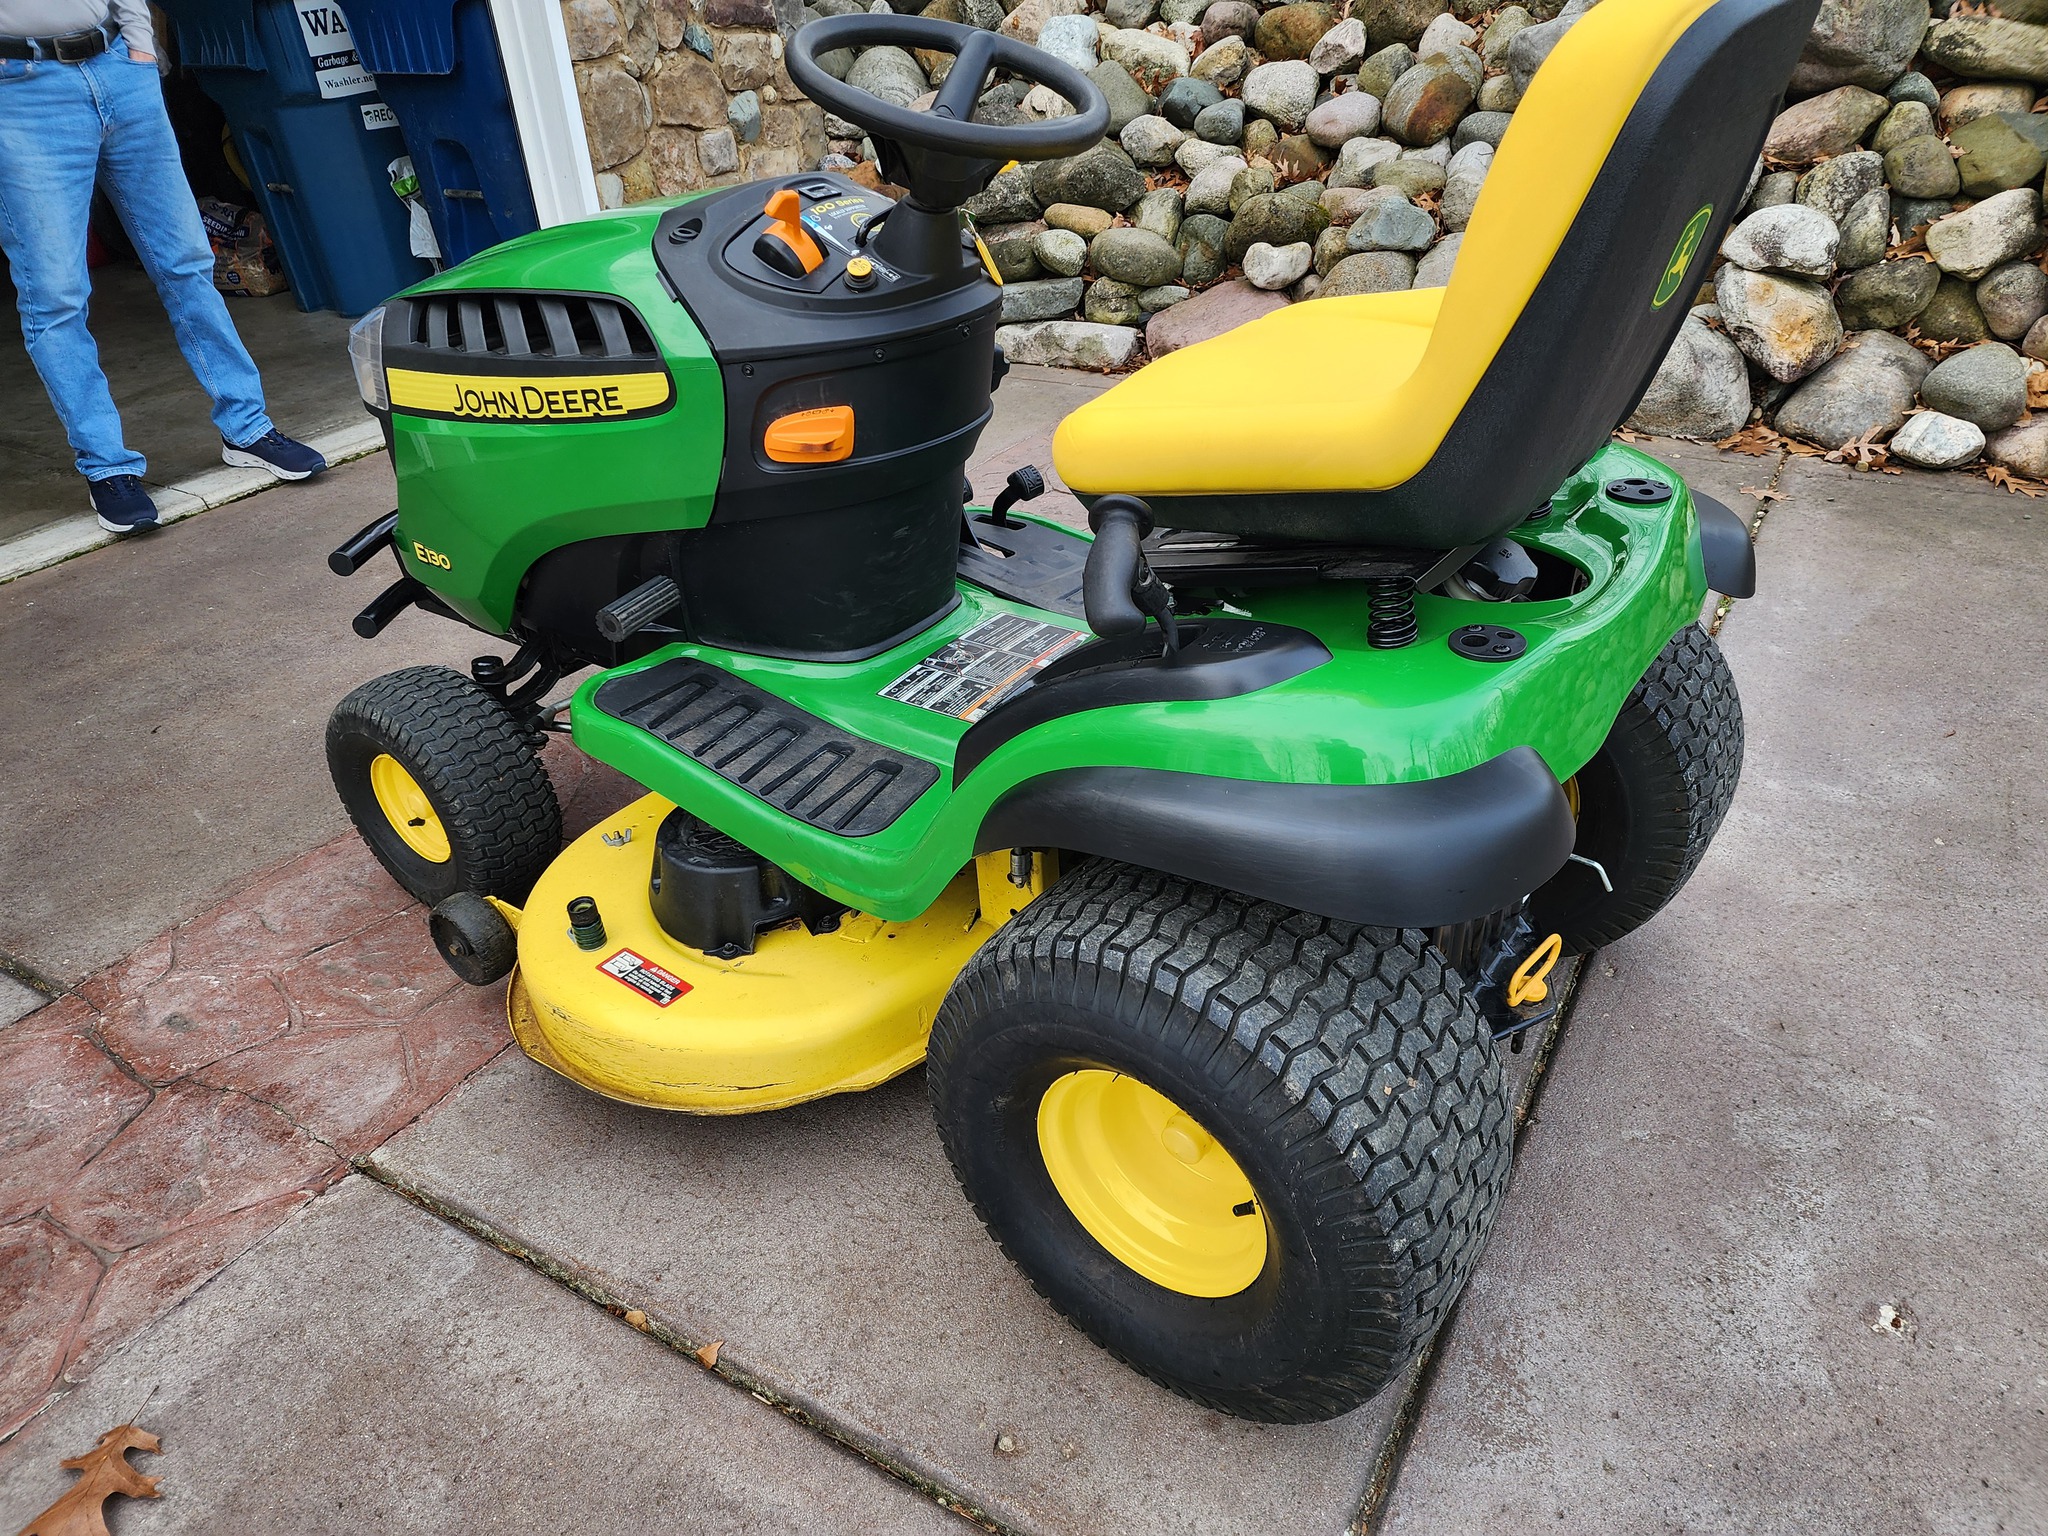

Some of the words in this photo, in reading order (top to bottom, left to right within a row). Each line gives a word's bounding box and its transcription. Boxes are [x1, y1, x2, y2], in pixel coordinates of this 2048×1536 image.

[301, 8, 347, 37] WA
[317, 54, 349, 68] Garbage
[373, 108, 394, 122] REC
[810, 202, 835, 215] 100
[835, 197, 864, 207] Series
[453, 384, 520, 414] JOHN
[520, 386, 623, 414] DEERE
[412, 541, 451, 570] E130
[656, 968, 681, 985] DANGER
